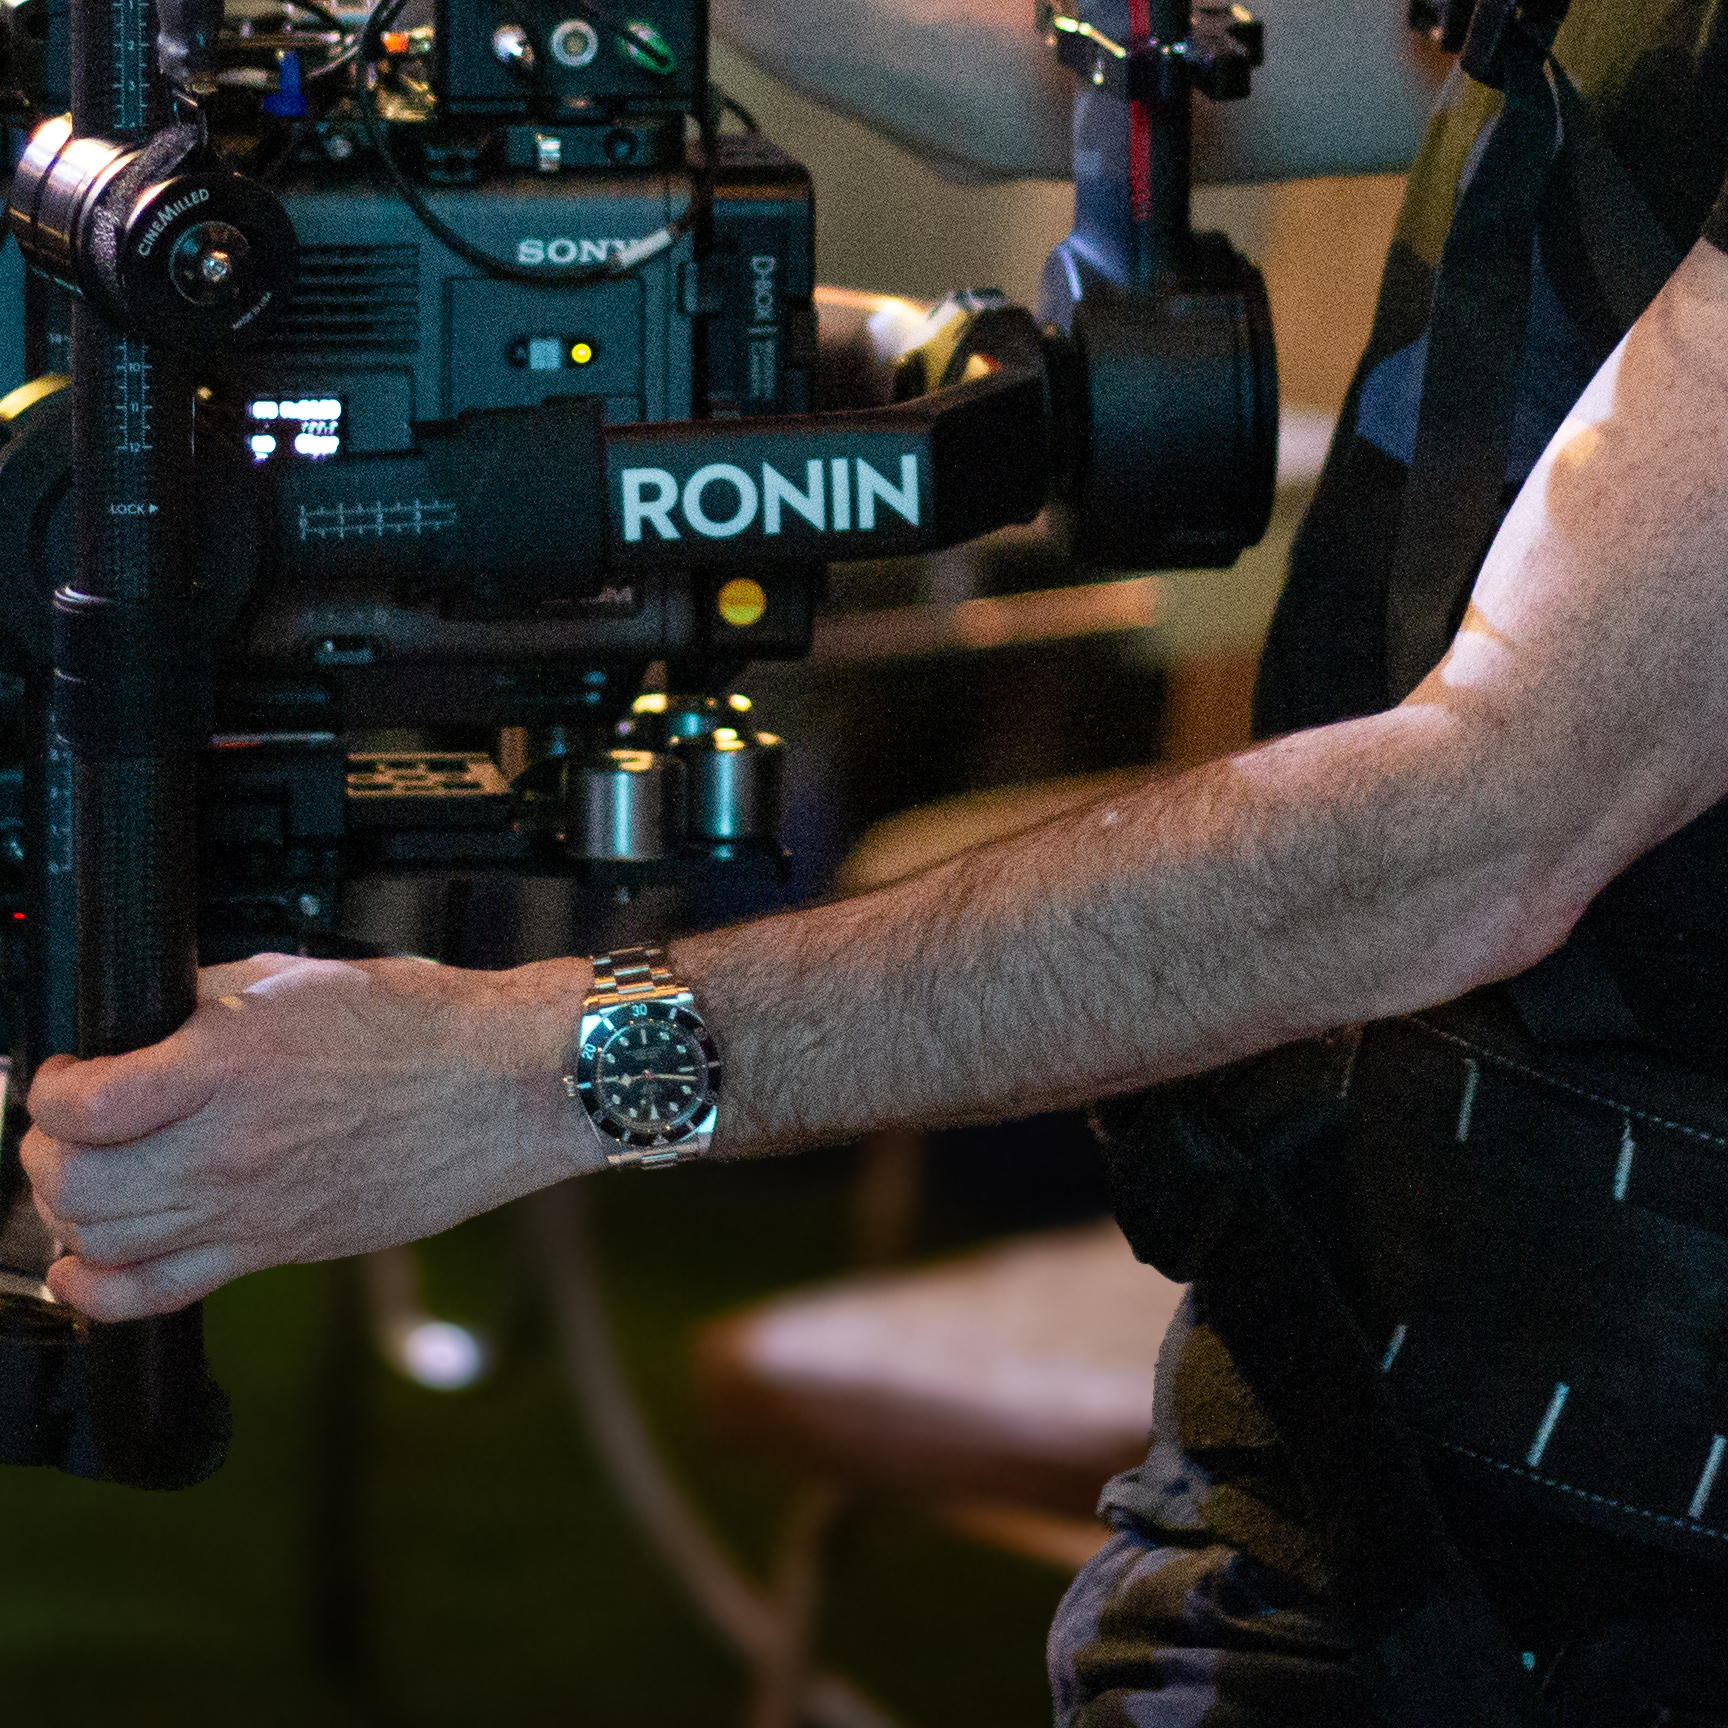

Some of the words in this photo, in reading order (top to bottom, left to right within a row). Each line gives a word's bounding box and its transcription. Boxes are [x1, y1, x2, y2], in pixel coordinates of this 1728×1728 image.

[620, 454, 920, 544] RONIN
[109, 503, 145, 515] LOCK
[631, 1003, 648, 1017] 30
[581, 1043, 597, 1061] 20
